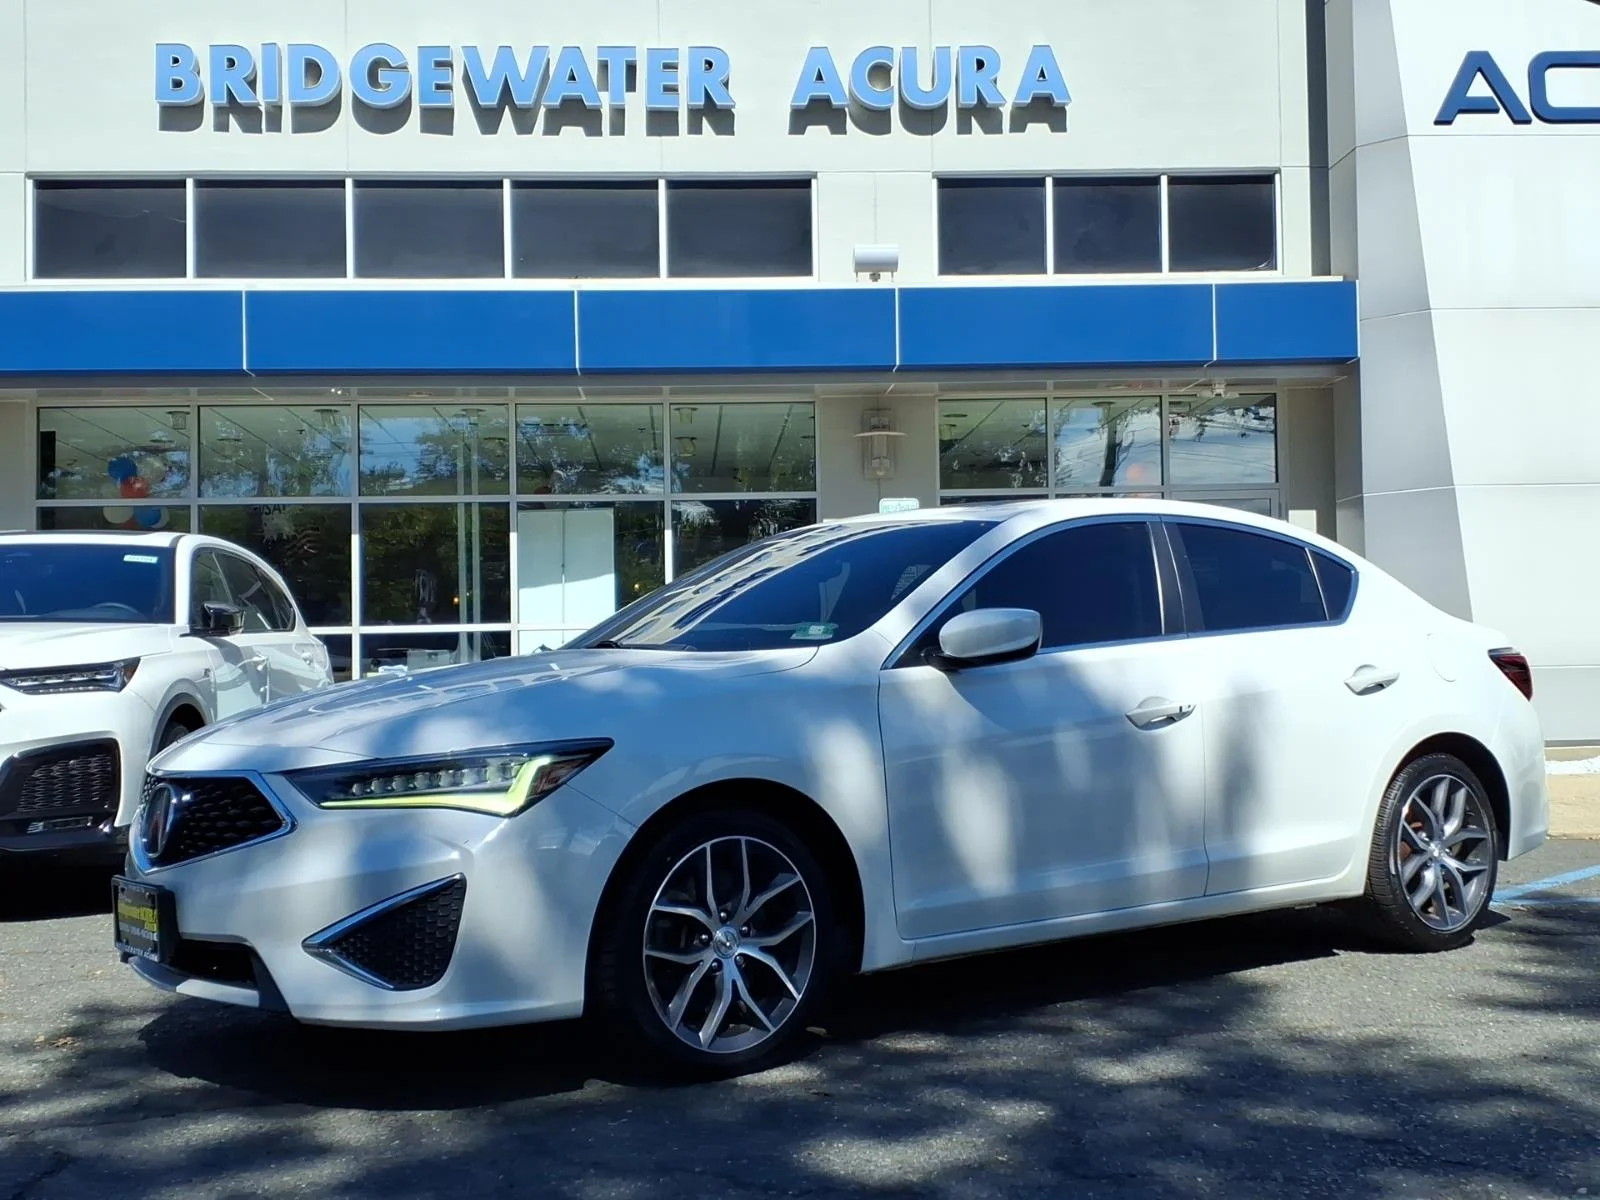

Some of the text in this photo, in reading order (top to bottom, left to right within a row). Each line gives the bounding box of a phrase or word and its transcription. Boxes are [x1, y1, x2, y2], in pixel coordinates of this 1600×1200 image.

[155, 43, 1072, 110] BRIDGEWATER ACURA
[1433, 50, 1600, 125] AC
